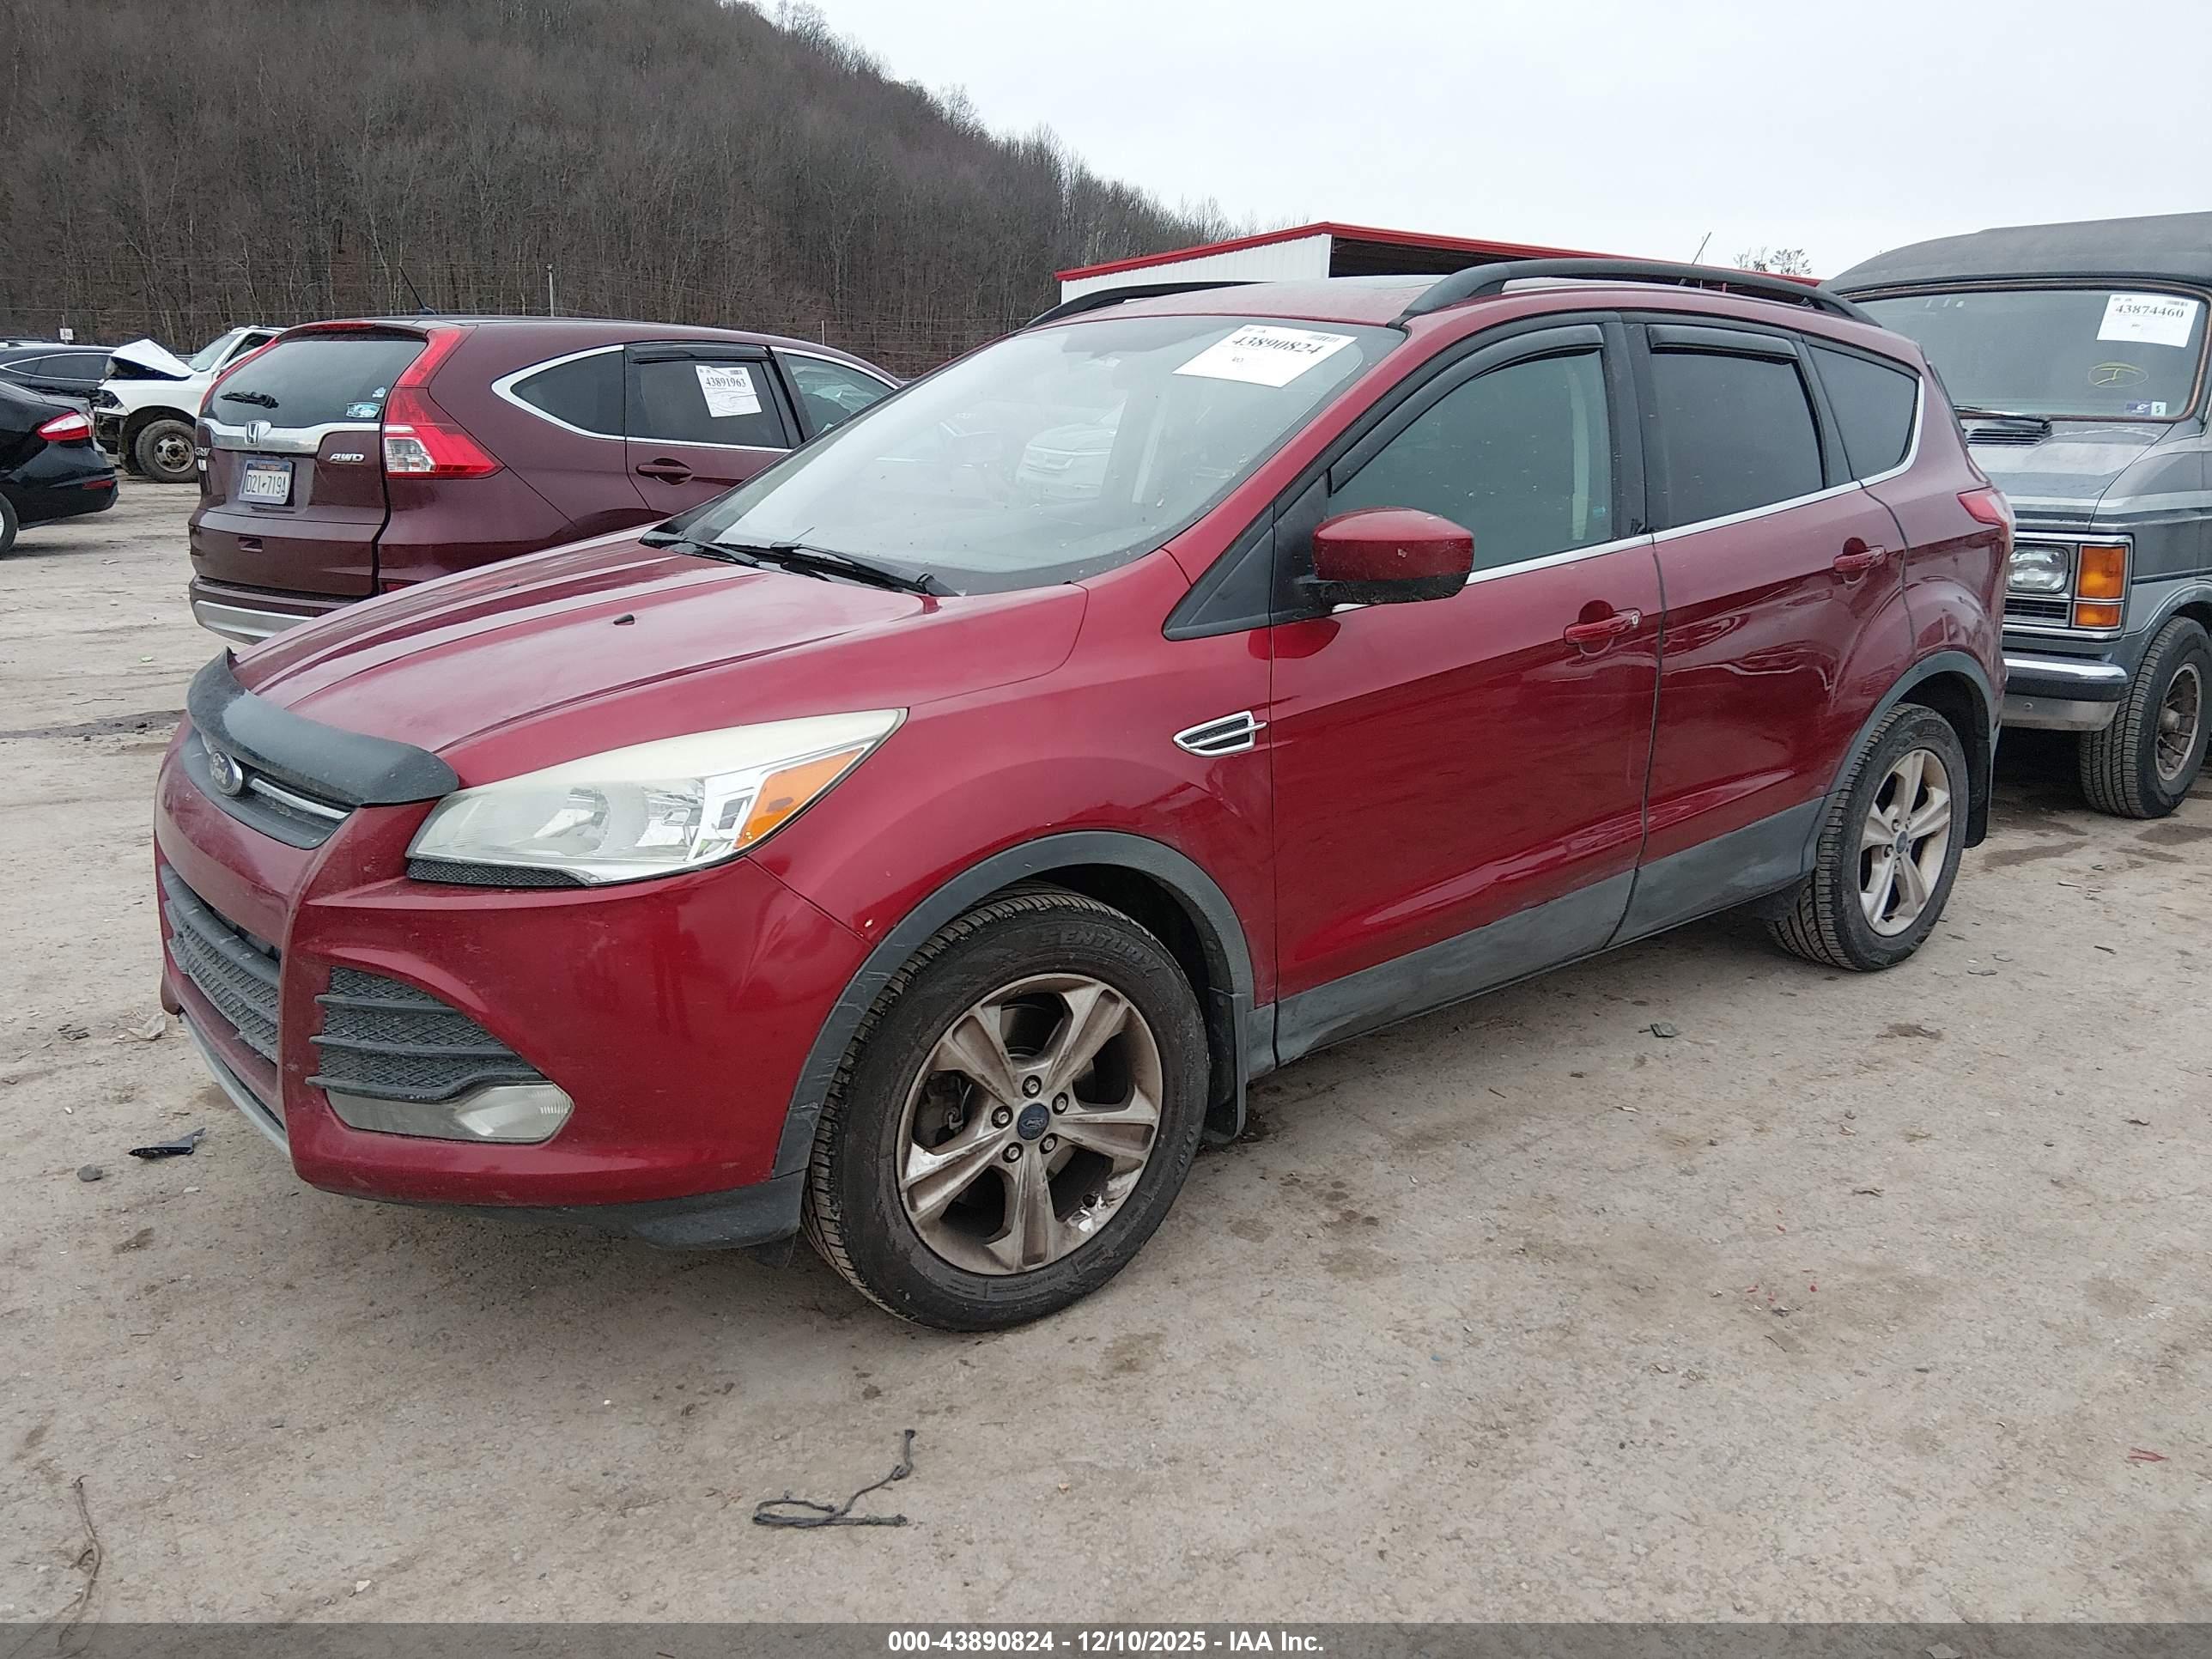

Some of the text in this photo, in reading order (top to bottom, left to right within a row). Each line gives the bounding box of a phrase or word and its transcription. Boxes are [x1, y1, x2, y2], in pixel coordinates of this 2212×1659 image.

[2115, 304, 2185, 319] 43874460
[1231, 336, 1325, 355] 43890824
[705, 377, 746, 387] 43891963
[329, 453, 365, 462] AWD
